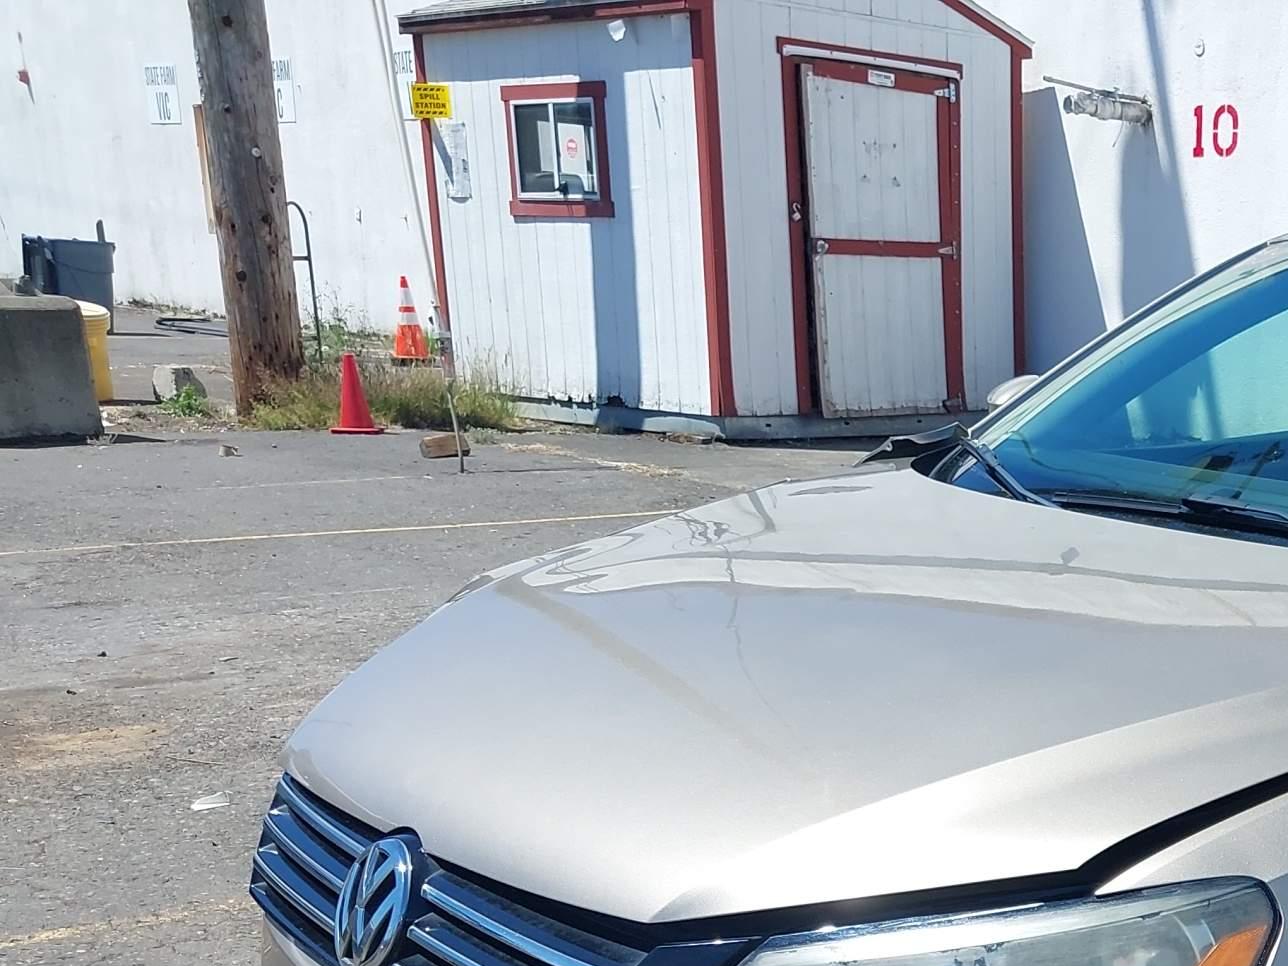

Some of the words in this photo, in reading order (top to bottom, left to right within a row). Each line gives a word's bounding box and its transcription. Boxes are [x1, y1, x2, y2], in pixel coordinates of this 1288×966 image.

[393, 50, 413, 74] STATE
[144, 66, 160, 86] STATE
[160, 66, 175, 86] FARM
[155, 91, 171, 120] VIC
[419, 93, 441, 101] SPILL
[1193, 104, 1238, 157] 10
